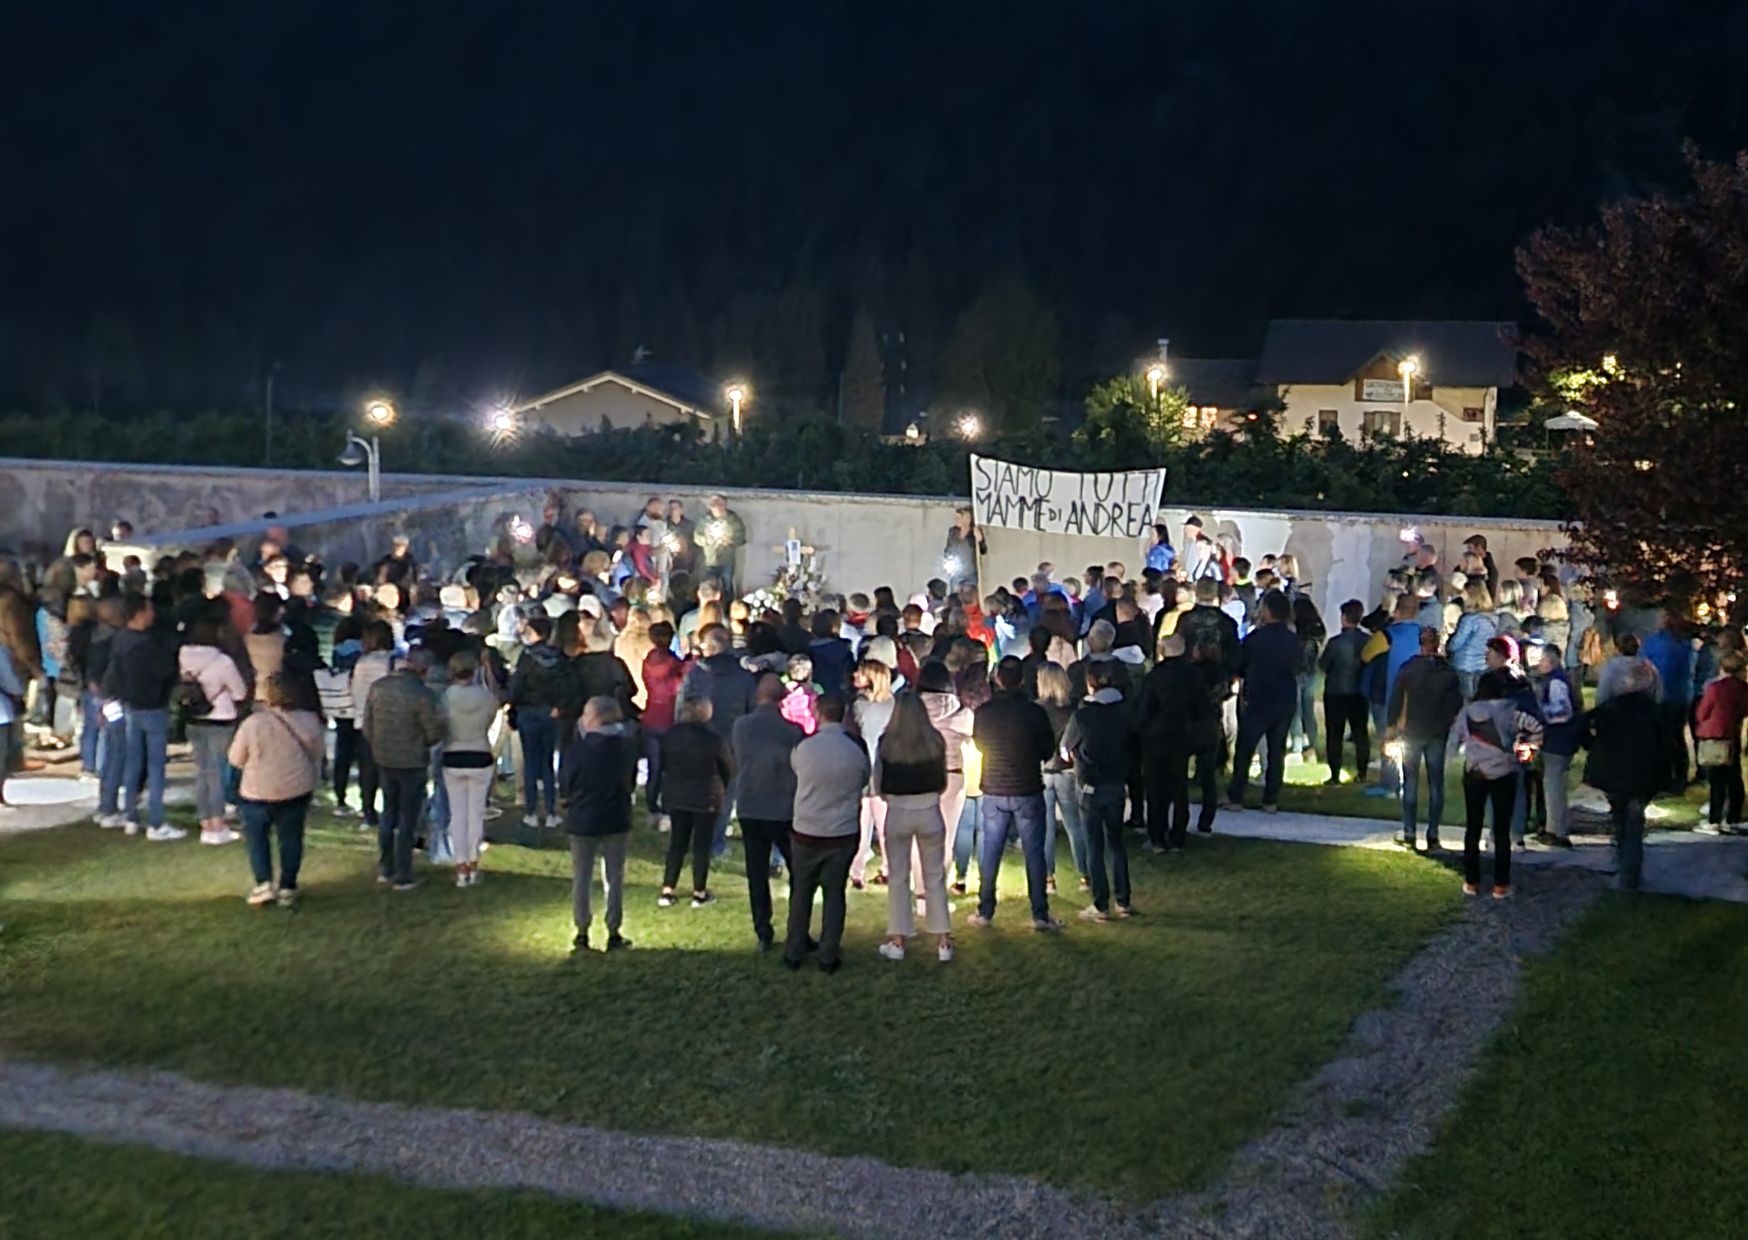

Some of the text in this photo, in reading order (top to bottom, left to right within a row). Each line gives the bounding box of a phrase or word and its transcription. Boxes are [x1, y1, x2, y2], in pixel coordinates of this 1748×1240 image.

[975, 458, 1160, 503] SIAMO TUTTI
[976, 491, 1153, 538] MAMME DI ANDREA
